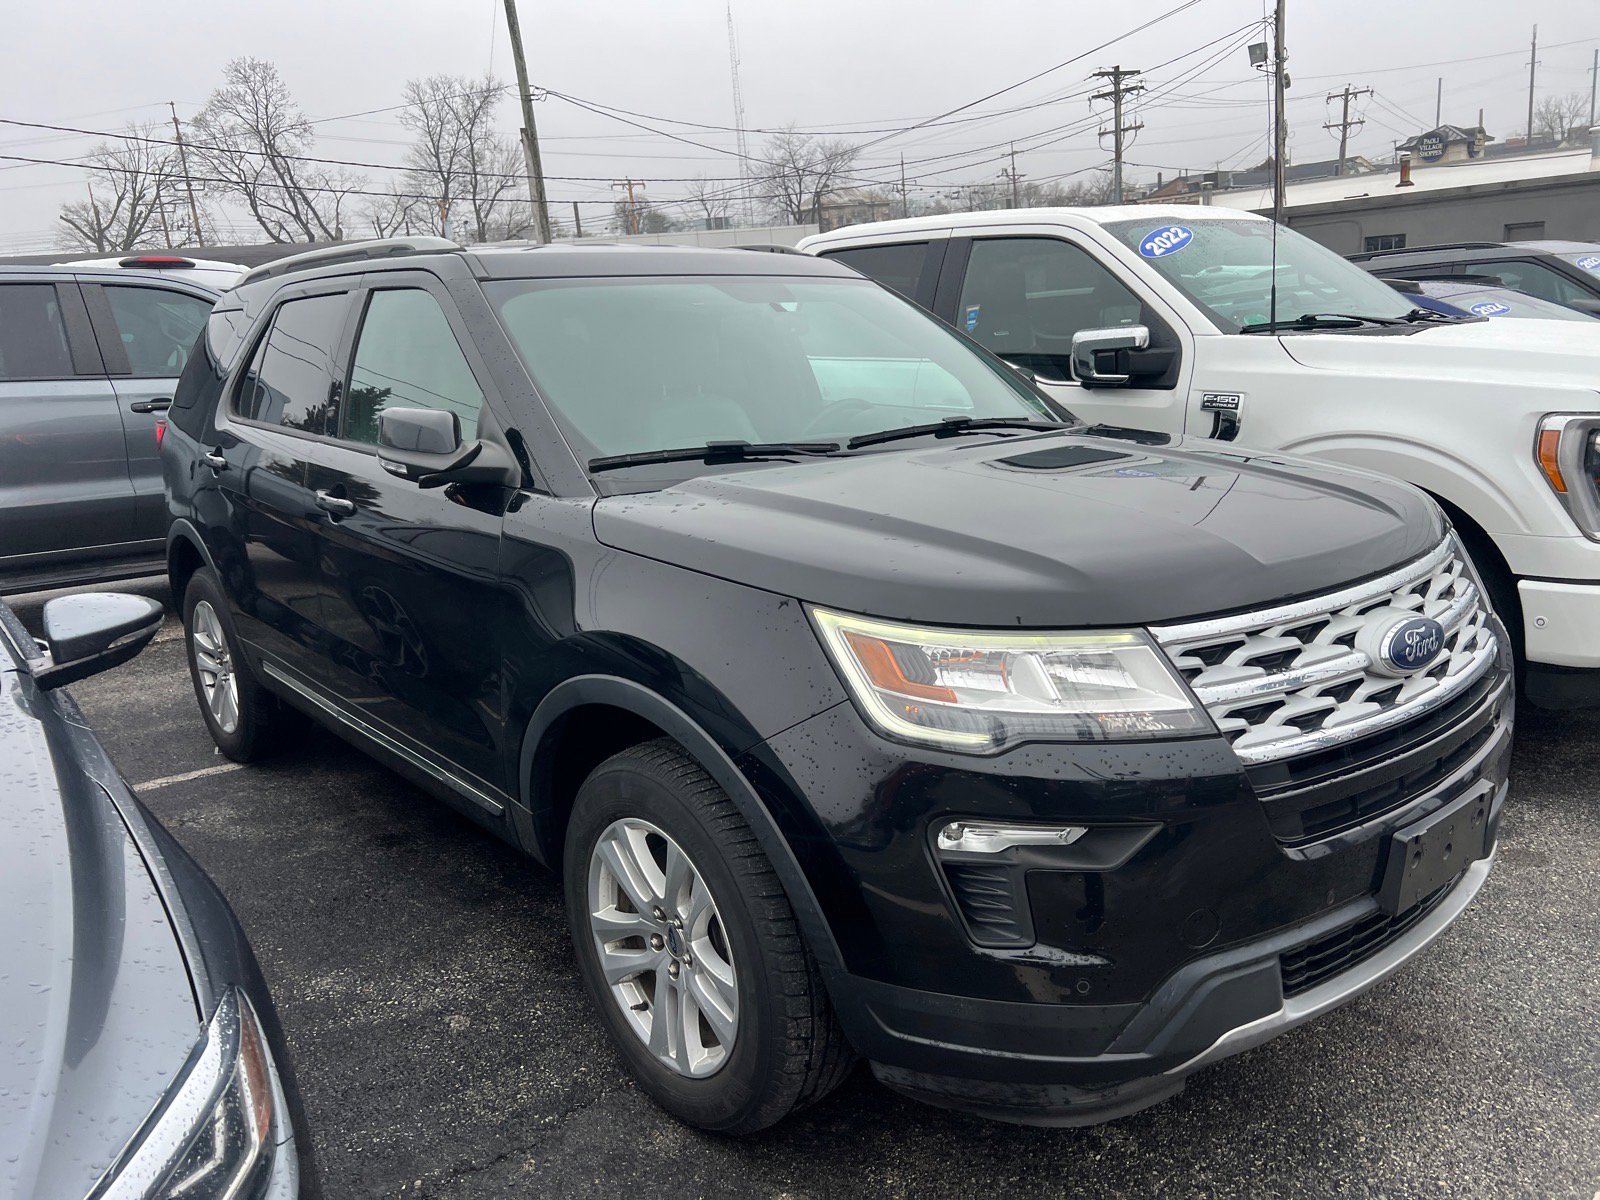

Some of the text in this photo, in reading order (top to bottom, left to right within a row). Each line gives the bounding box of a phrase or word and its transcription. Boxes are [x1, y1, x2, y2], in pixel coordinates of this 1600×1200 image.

[1423, 137, 1440, 145] PAOLI
[1420, 143, 1443, 151] VILLAGE
[1420, 149, 1443, 157] SHOPPES
[1145, 227, 1190, 256] 2022
[1474, 303, 1508, 315] 2024
[1204, 395, 1239, 403] F-150
[1404, 625, 1439, 662] Ford
